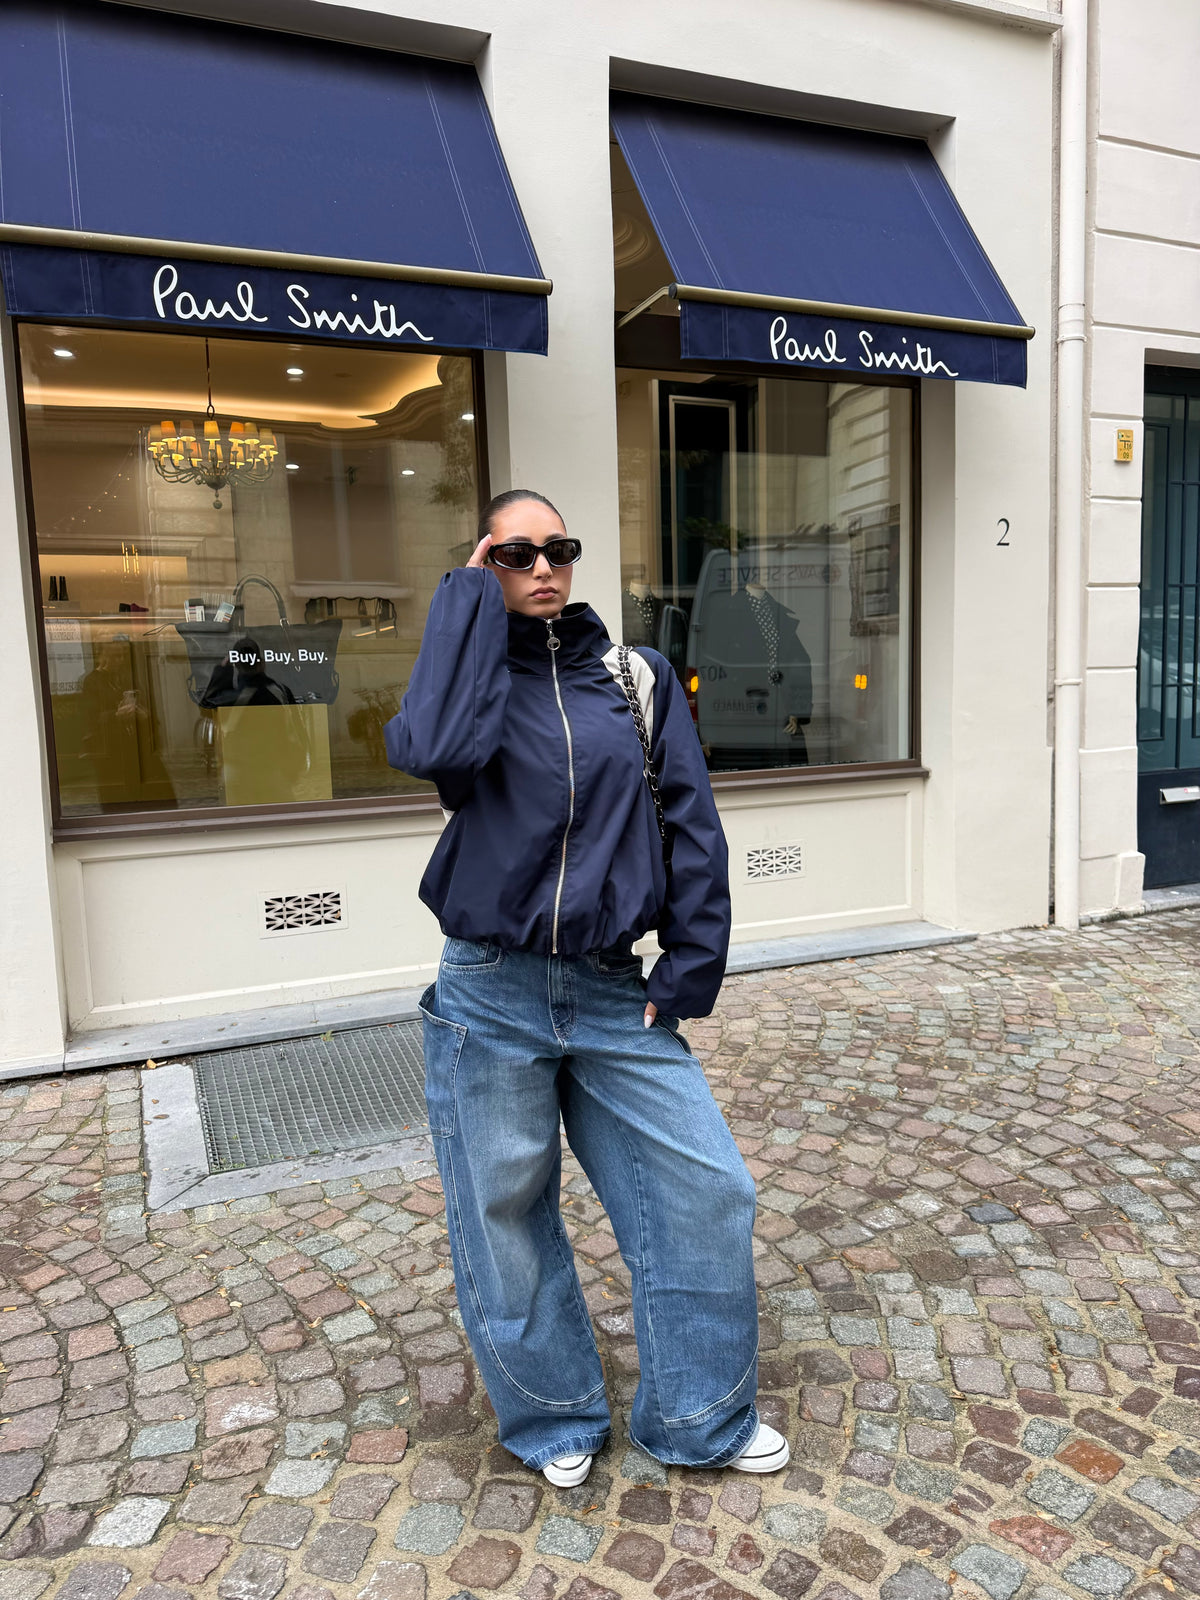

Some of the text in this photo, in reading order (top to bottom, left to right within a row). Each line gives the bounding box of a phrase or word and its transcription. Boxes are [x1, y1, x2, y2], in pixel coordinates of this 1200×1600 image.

[153, 264, 434, 342] Paul Smith
[770, 316, 959, 377] Paul Smith
[996, 517, 1010, 546] 2
[228, 648, 328, 666] Buy. Buy. Buy.
